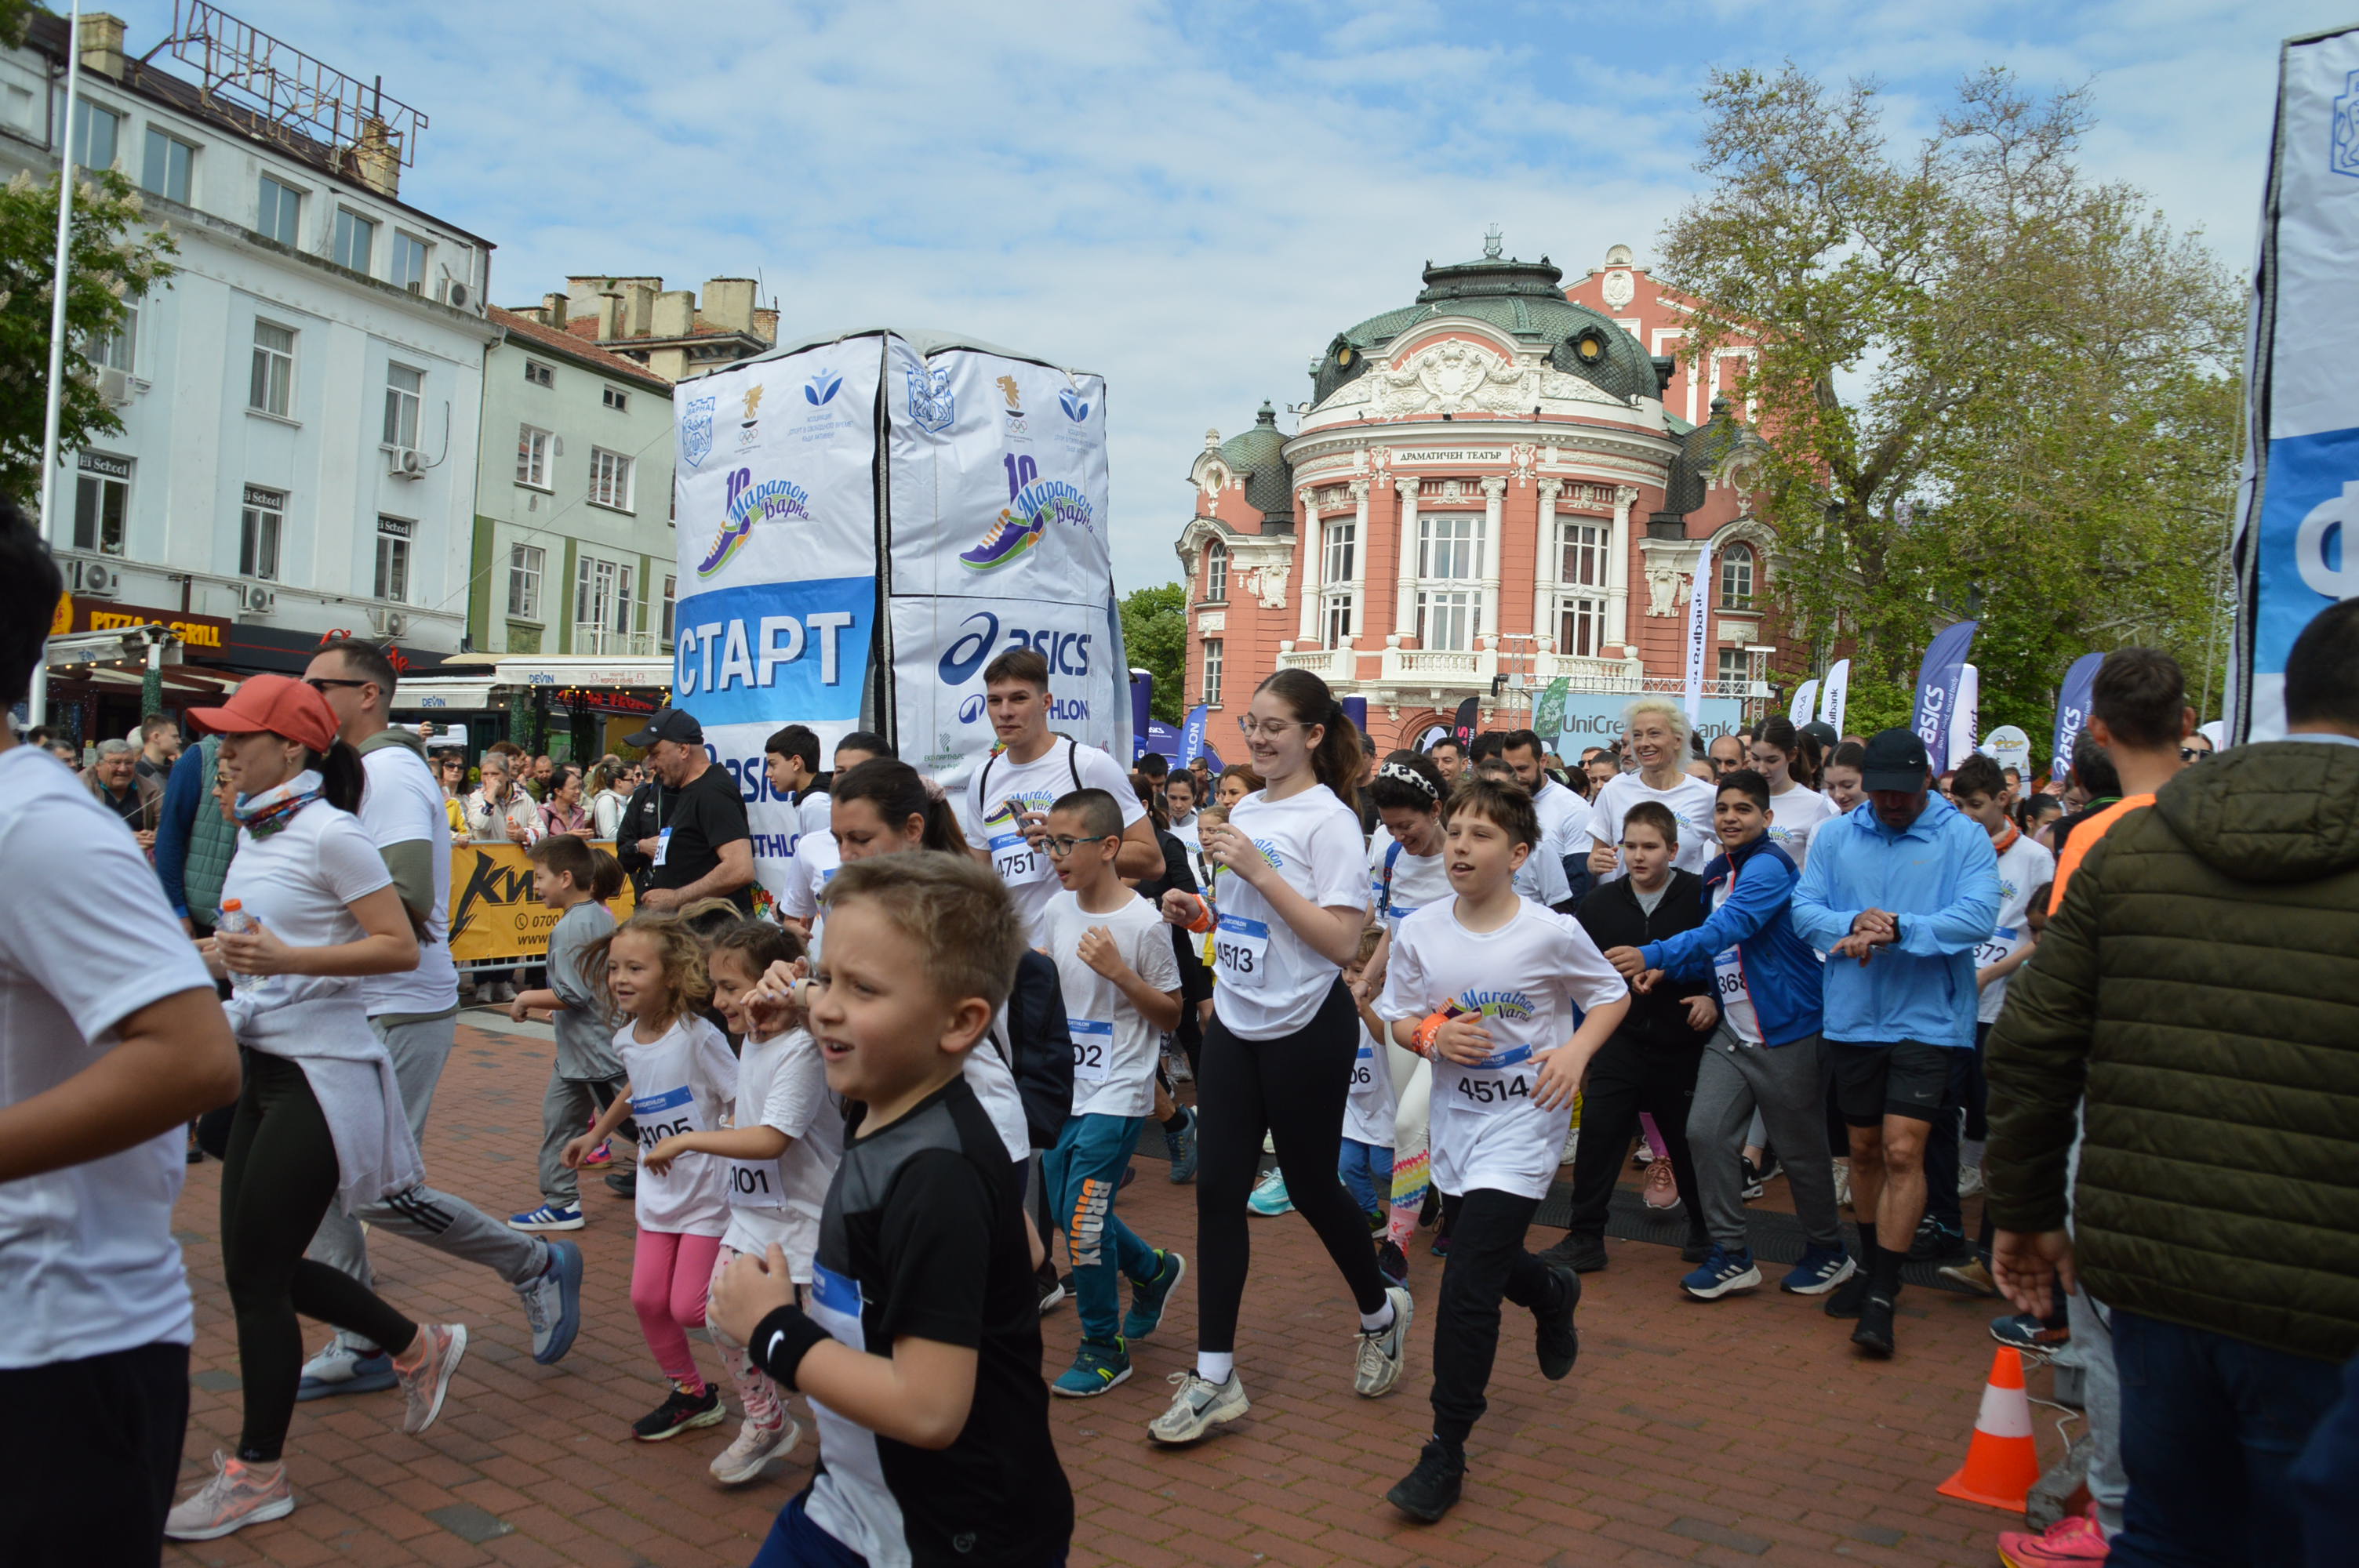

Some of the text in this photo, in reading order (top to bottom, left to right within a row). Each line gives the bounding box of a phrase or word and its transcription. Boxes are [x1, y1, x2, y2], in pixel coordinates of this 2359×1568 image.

[79, 455, 127, 476] Hi School
[1400, 451, 1502, 461] ДРАМАТИЧЕН ТЕАТЪР
[253, 492, 280, 507] School
[730, 479, 809, 528] Маратон
[761, 496, 809, 521] Варна
[385, 521, 409, 534] School
[1052, 498, 1094, 533] Варна
[169, 621, 221, 648] GRILL
[678, 612, 854, 696] СТАРТ
[529, 672, 554, 684] DEVIN
[422, 695, 446, 707] DEVIN
[1049, 699, 1090, 720] HLON
[1829, 688, 1838, 728] ulbank
[1562, 714, 1626, 735] UniCre
[998, 851, 1035, 877] 4751
[1218, 941, 1253, 973] 4513
[1973, 943, 2008, 963] 372
[1461, 989, 1536, 1013] Marathon
[1494, 1004, 1531, 1022] Varna
[1073, 1044, 1102, 1068] 02
[1350, 1067, 1371, 1084] 06
[1458, 1074, 1530, 1103] 4514
[639, 1116, 694, 1149] 4105
[729, 1165, 769, 1194] 101
[1070, 1178, 1113, 1266] BRONX
